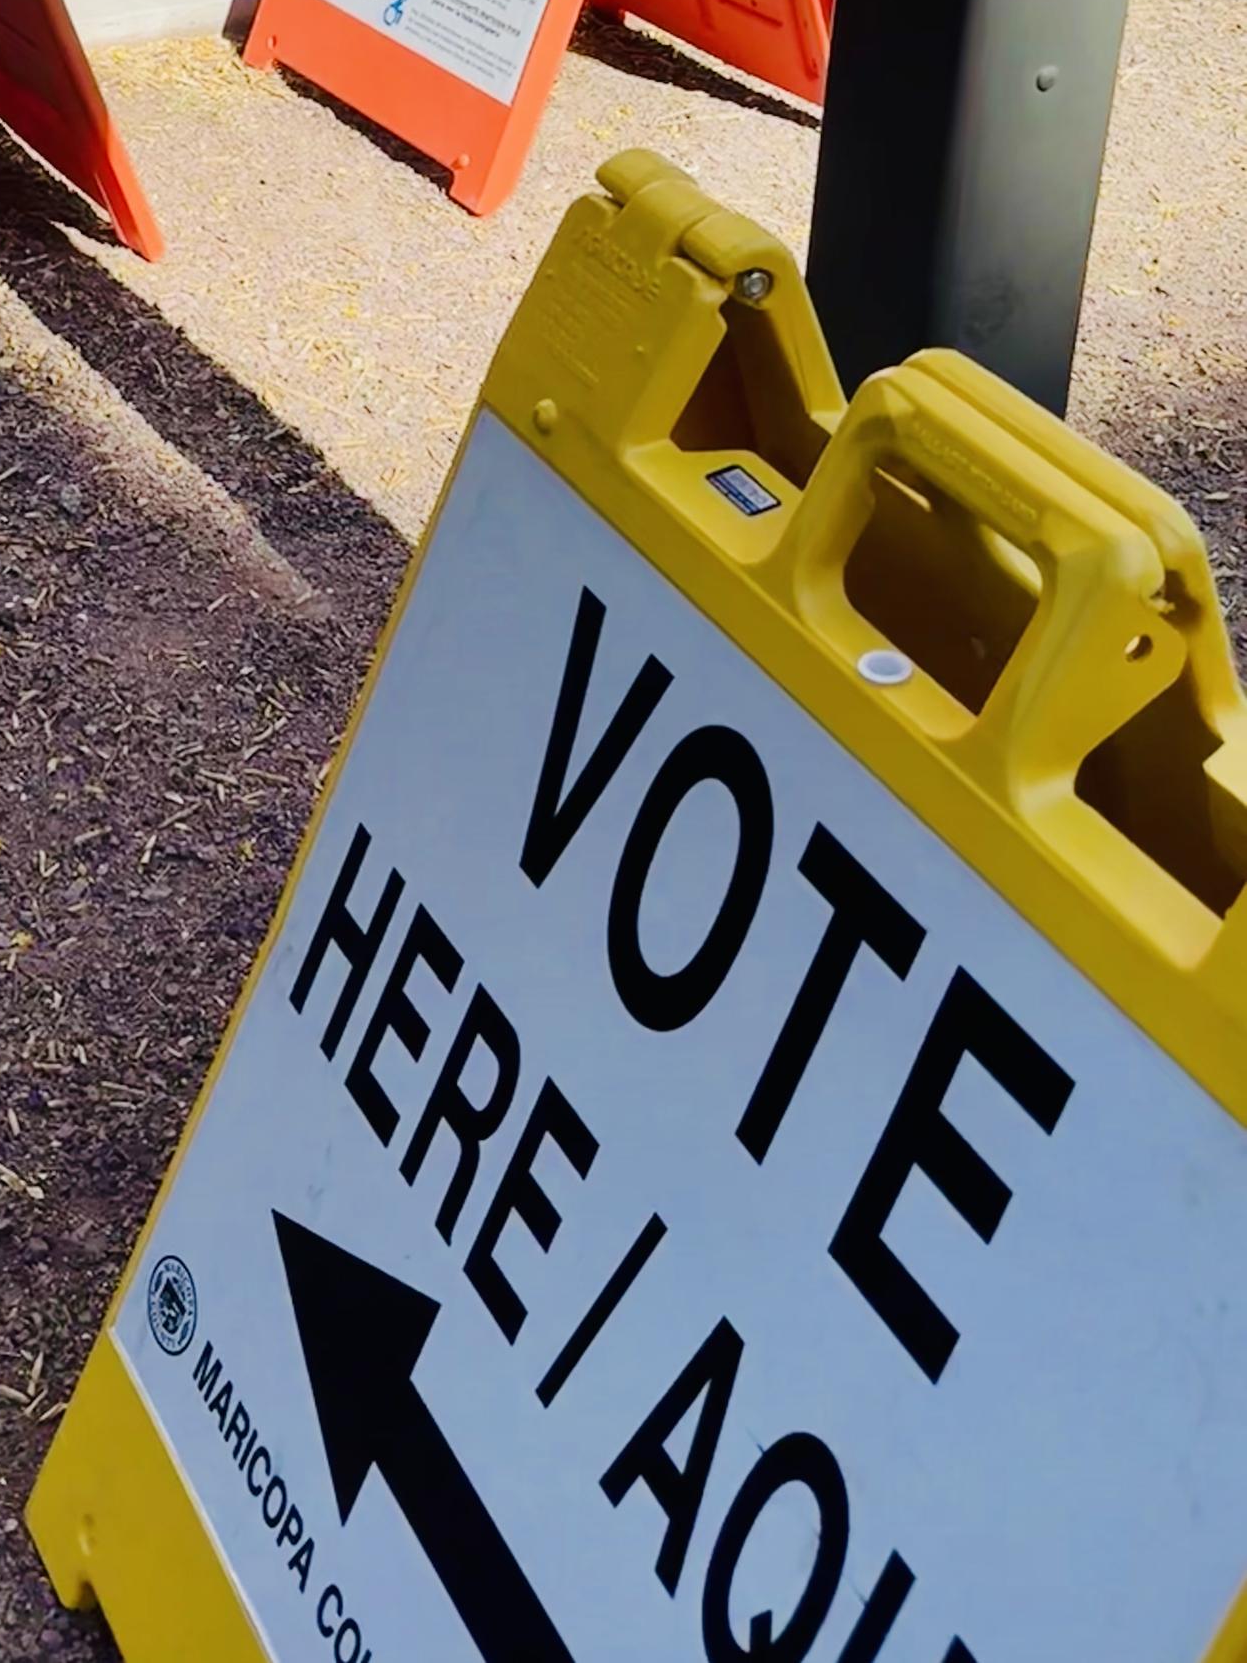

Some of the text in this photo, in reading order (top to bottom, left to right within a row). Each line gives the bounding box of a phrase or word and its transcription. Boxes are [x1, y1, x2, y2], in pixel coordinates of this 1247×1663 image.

[288, 822, 600, 1346] HERE
[535, 1211, 668, 1409] /
[519, 584, 1076, 1385] VOTE
[192, 1339, 315, 1594] MARICOPA
